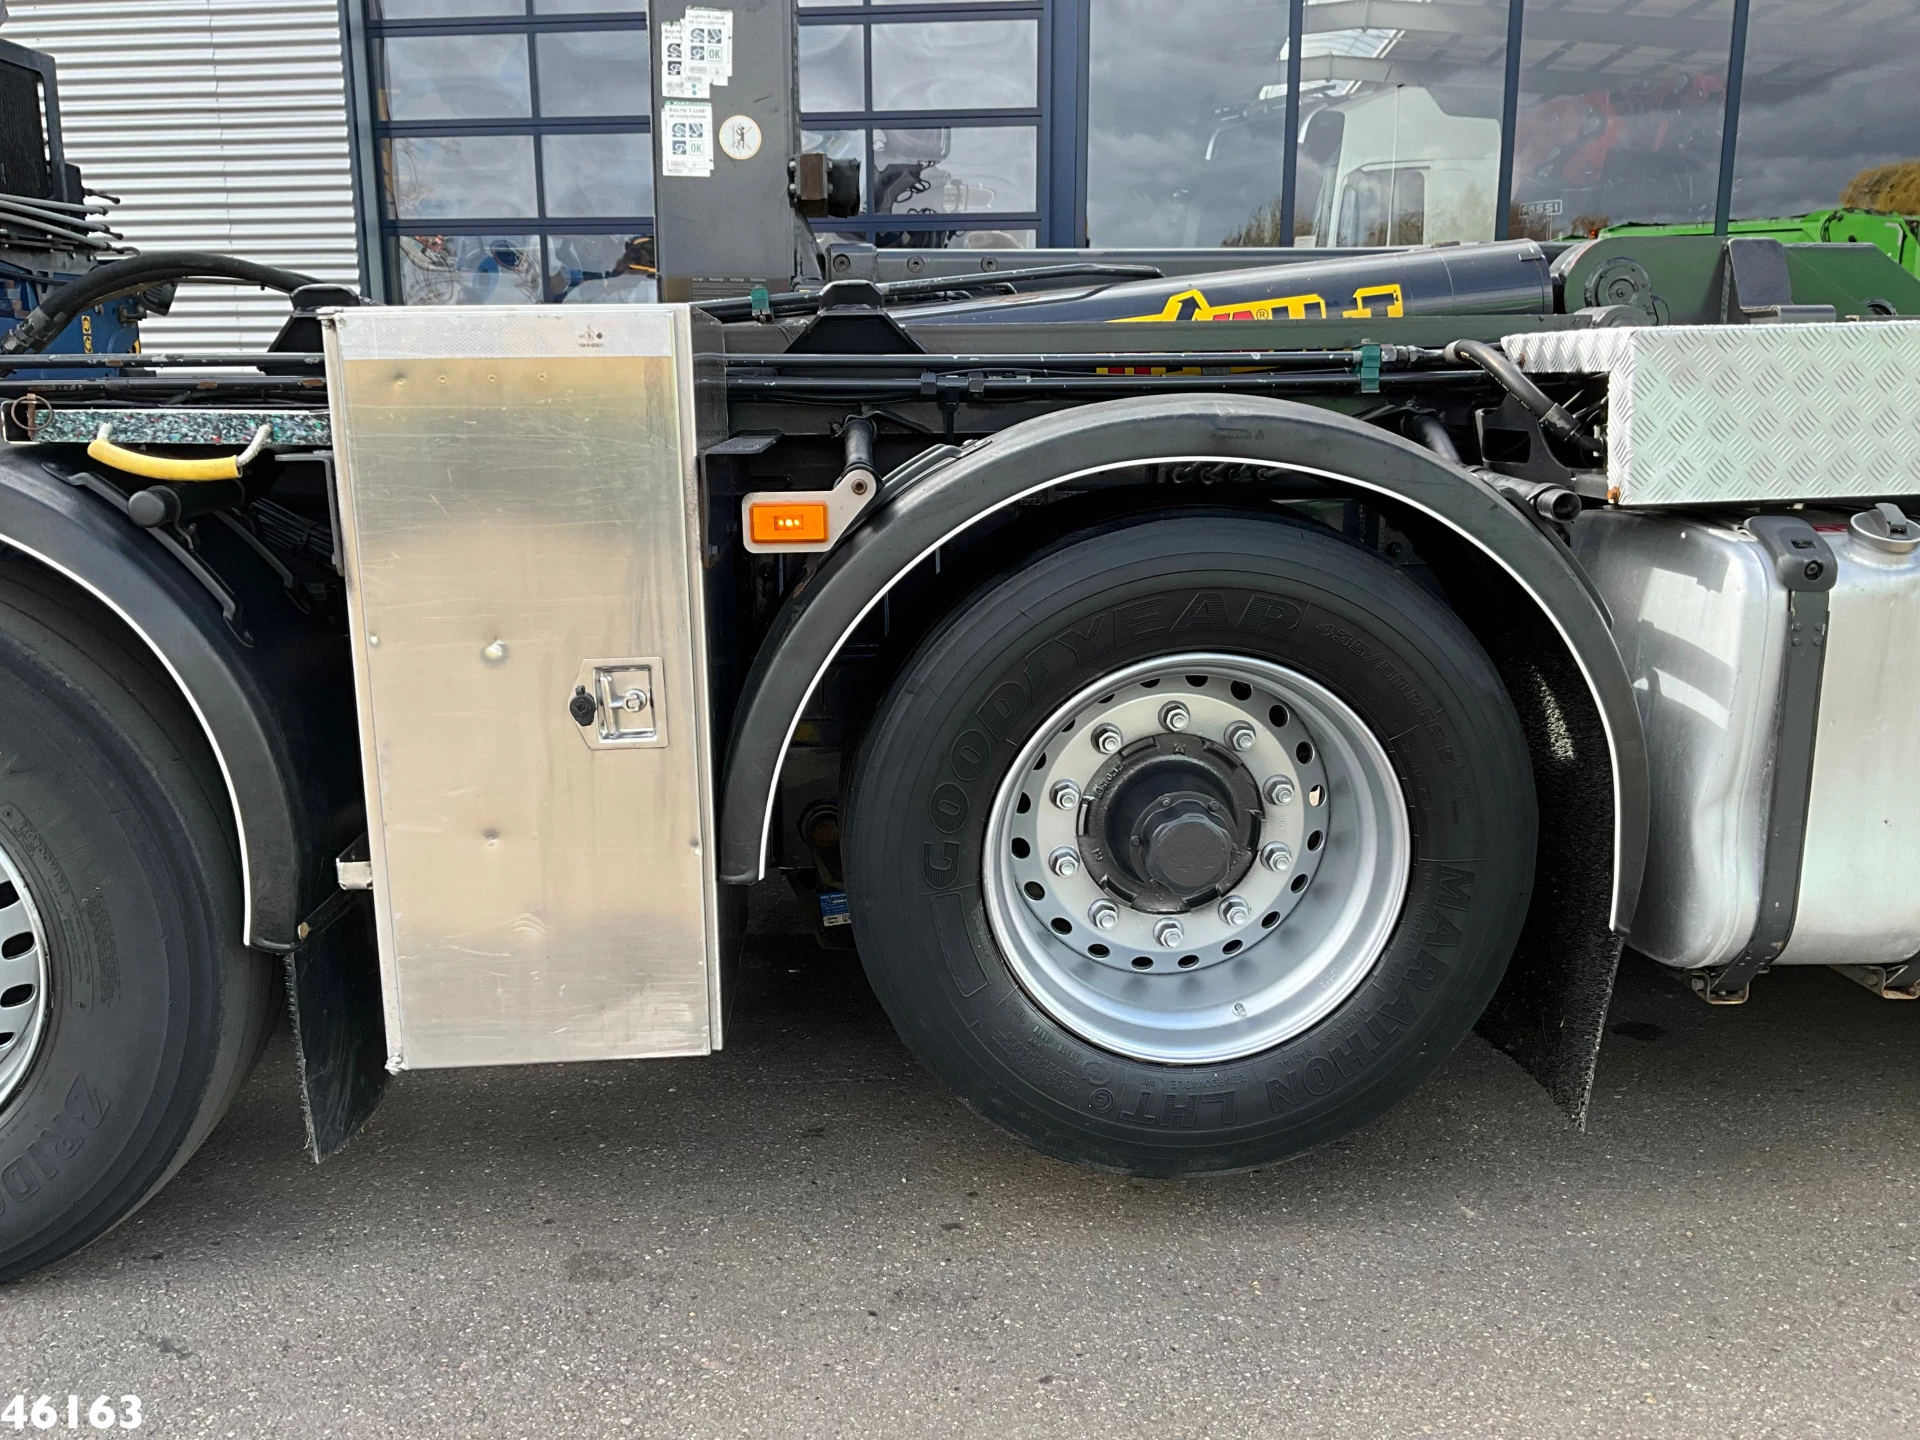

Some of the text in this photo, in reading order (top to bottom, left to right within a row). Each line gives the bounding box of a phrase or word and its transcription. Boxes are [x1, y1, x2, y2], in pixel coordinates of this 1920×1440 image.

[708, 49, 721, 60] OK
[690, 142, 703, 154] OK
[1522, 203, 1558, 215] FASSI
[921, 591, 1303, 889] GOODYEAR
[1119, 864, 1477, 1127] MARATHON LHT
[1278, 1005, 1368, 1068] TUBELESS RADIAL
[0, 1072, 111, 1217] BRID
